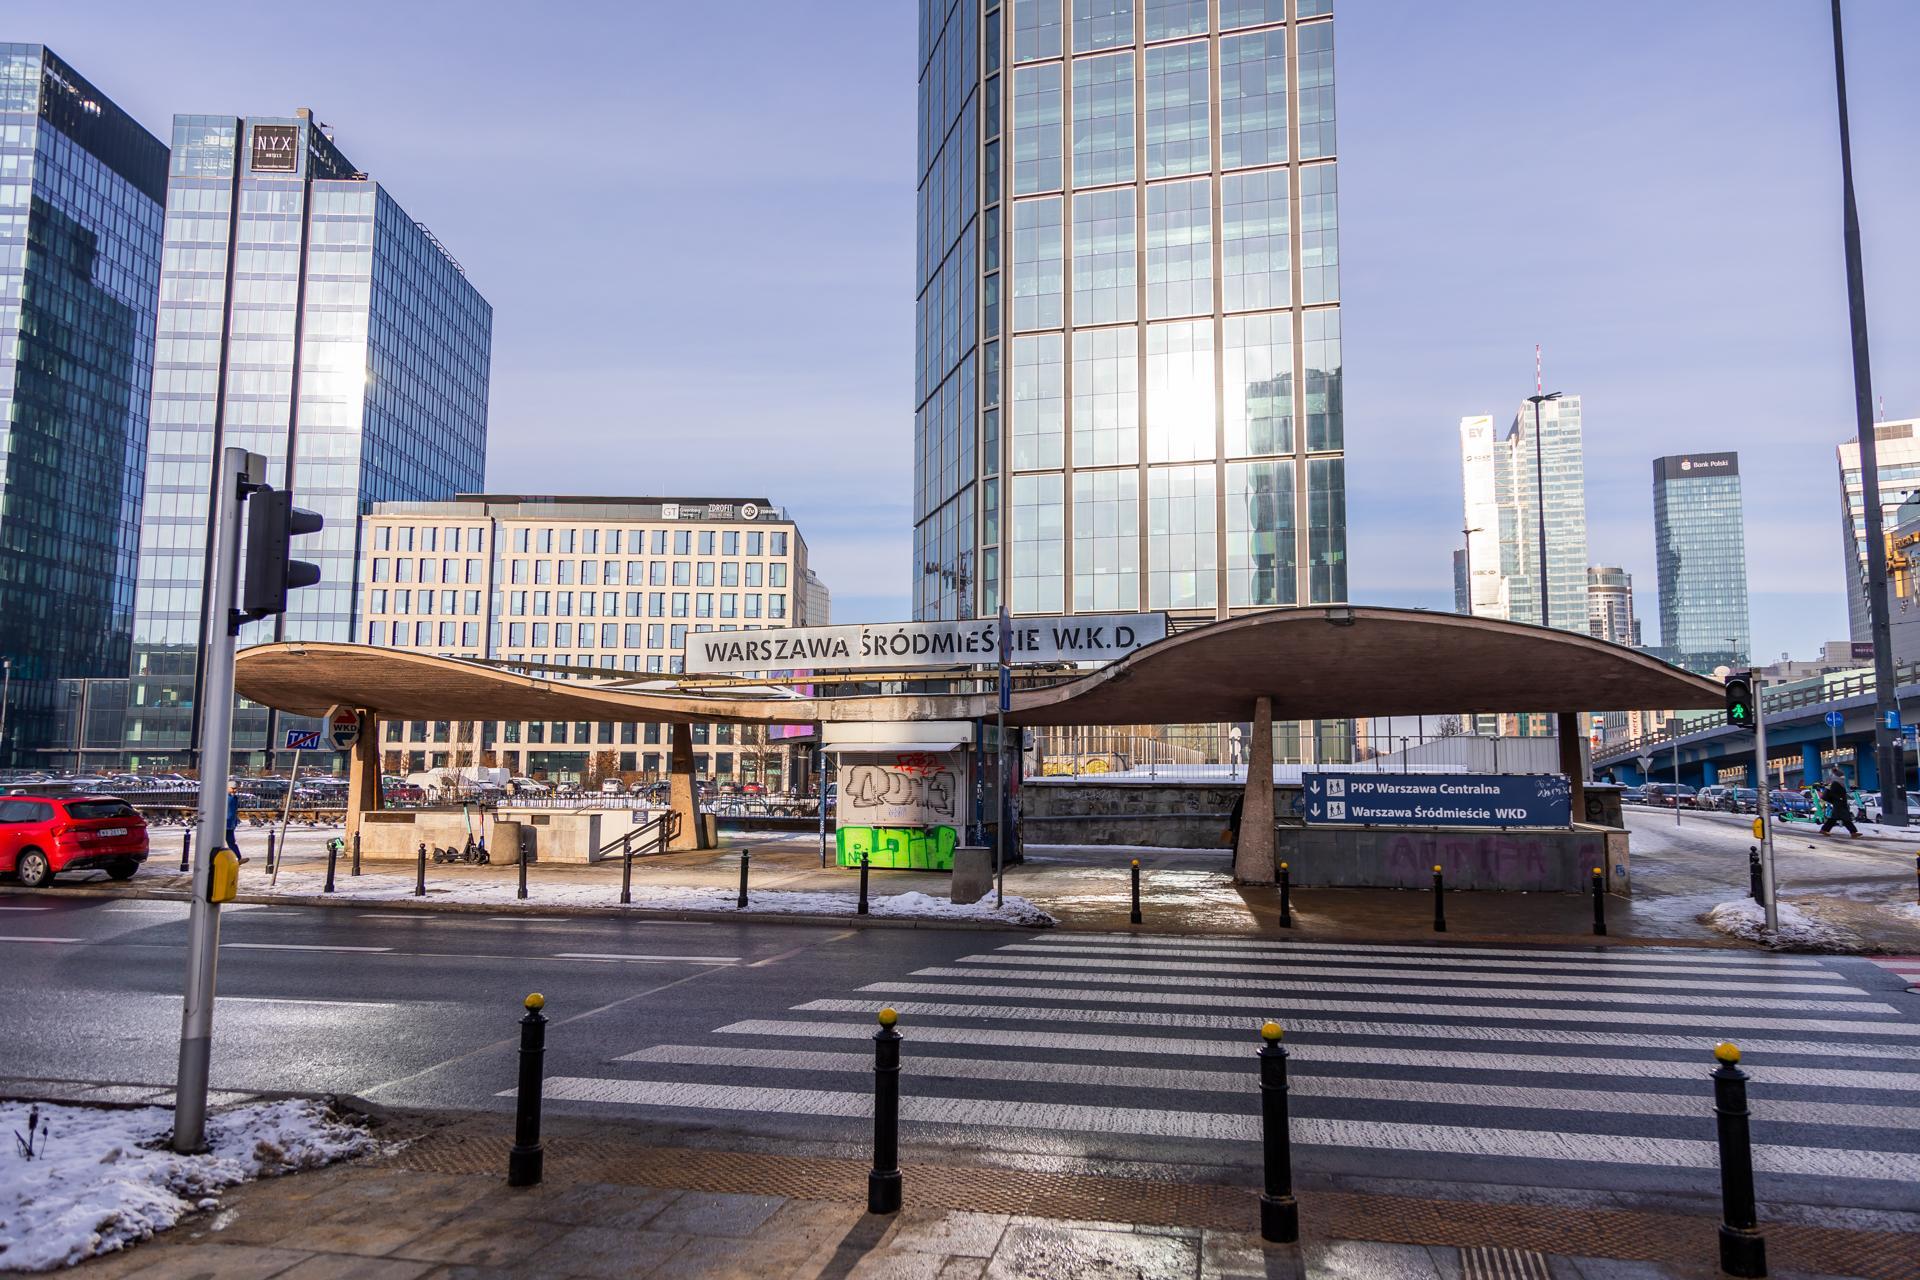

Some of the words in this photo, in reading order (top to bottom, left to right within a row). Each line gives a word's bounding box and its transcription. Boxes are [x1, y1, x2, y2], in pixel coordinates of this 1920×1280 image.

[258, 136, 291, 151] NYX
[1469, 428, 1484, 438] EY
[664, 507, 677, 516] GT
[708, 504, 733, 512] ZDROFIT
[704, 637, 850, 662] WARSZAWA
[1052, 626, 1142, 650] W.K.D.
[289, 732, 319, 748] TAXI
[1351, 782, 1374, 793] PKP
[1376, 783, 1437, 794] Warszawa
[1440, 783, 1500, 794] Centralna
[1352, 806, 1412, 817] Warszawa
[1415, 805, 1490, 818] Śródmieście
[1495, 808, 1527, 819] WKD
